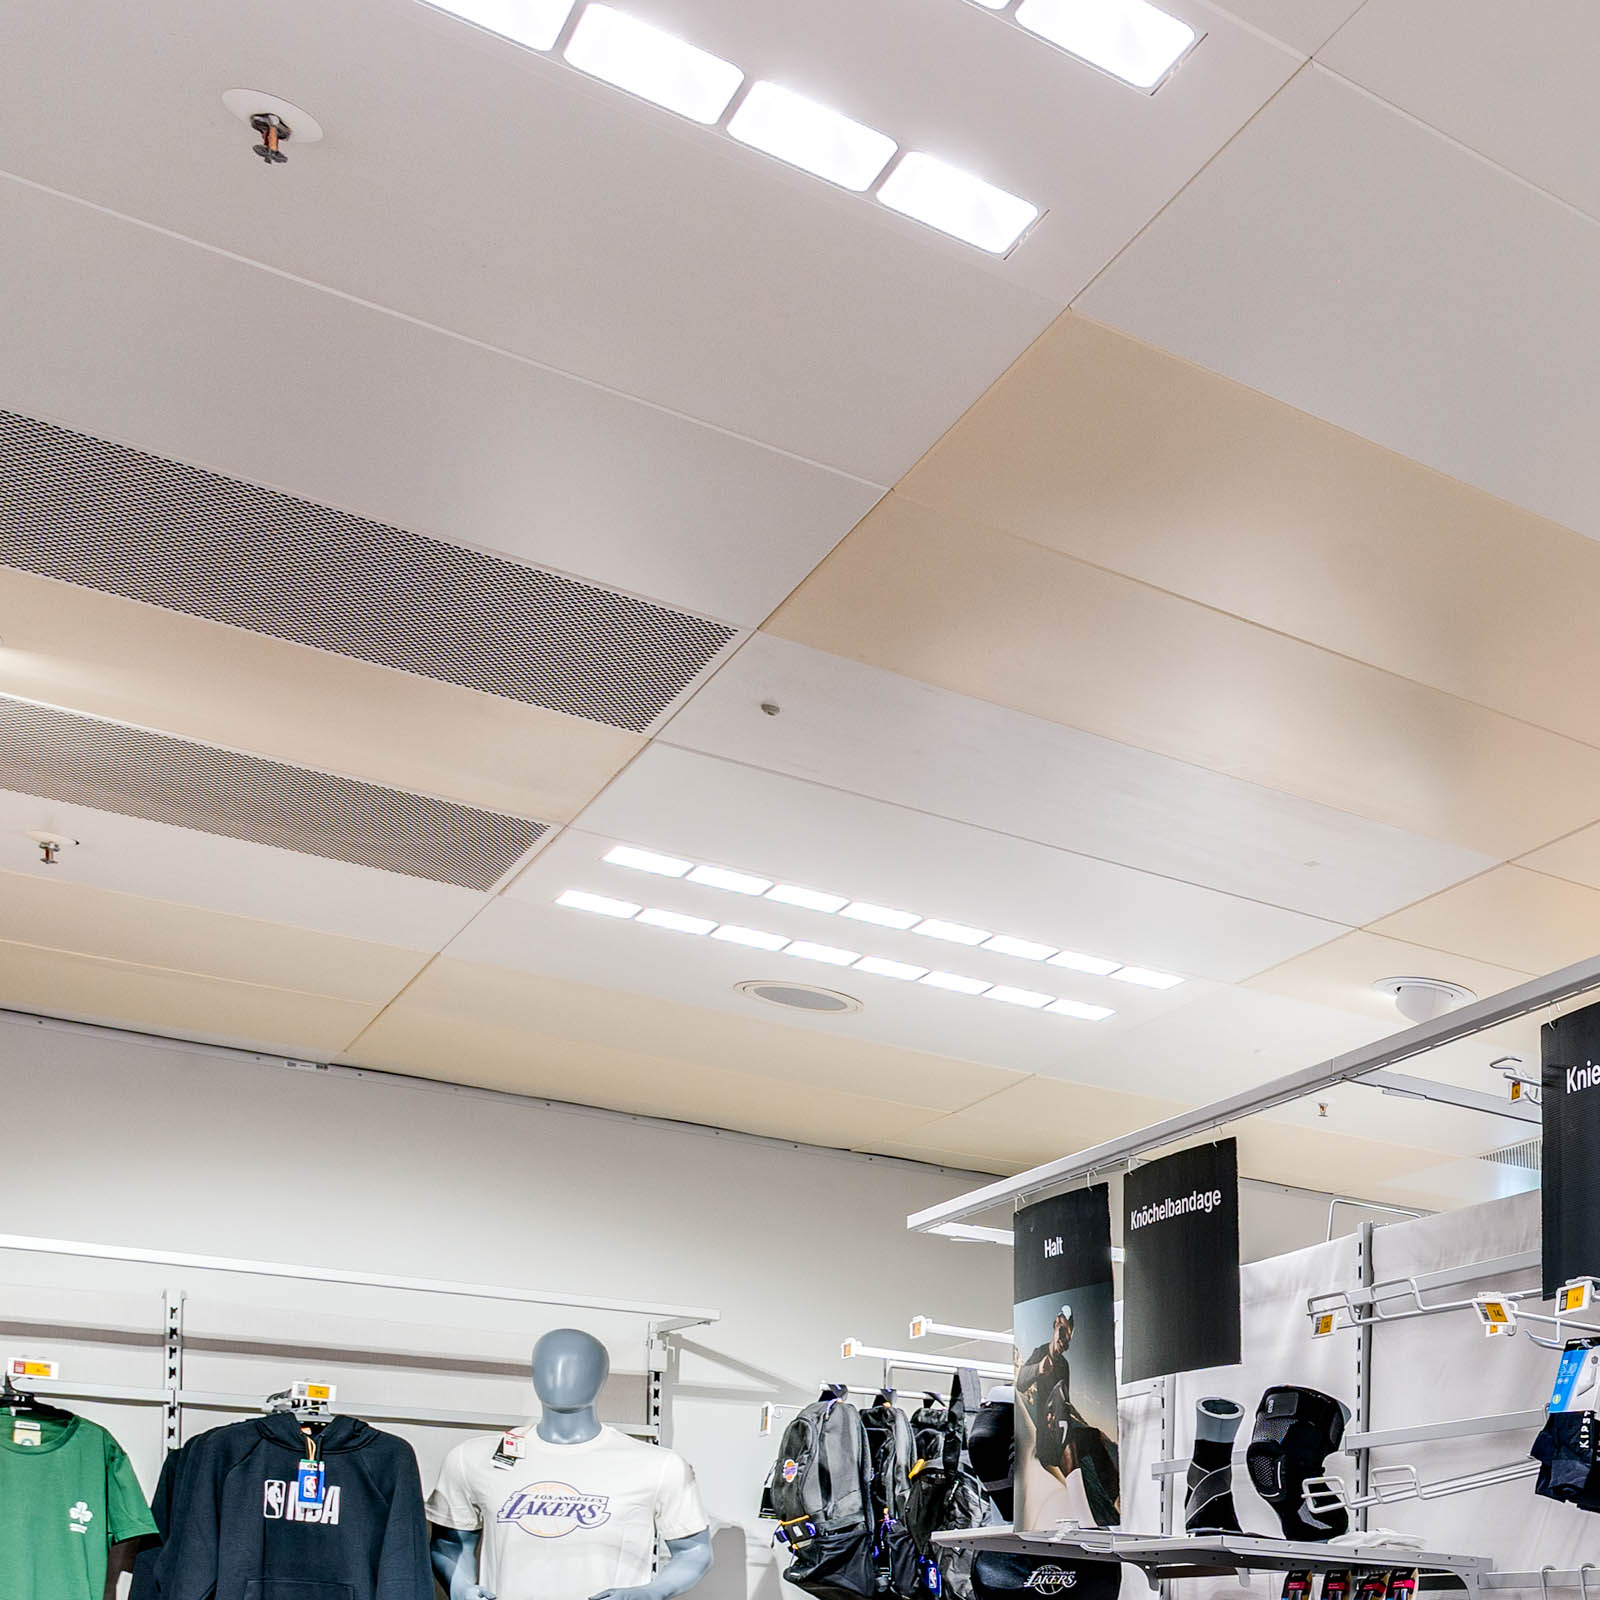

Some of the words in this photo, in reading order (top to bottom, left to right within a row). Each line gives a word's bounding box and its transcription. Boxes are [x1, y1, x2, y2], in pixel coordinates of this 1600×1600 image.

[1130, 1189, 1222, 1231] Knöchelbandage
[1044, 1235, 1064, 1259] Halt
[1058, 1420, 1069, 1444] 7
[505, 1494, 602, 1526] LAKERS
[1025, 1571, 1077, 1588] LAKERS
